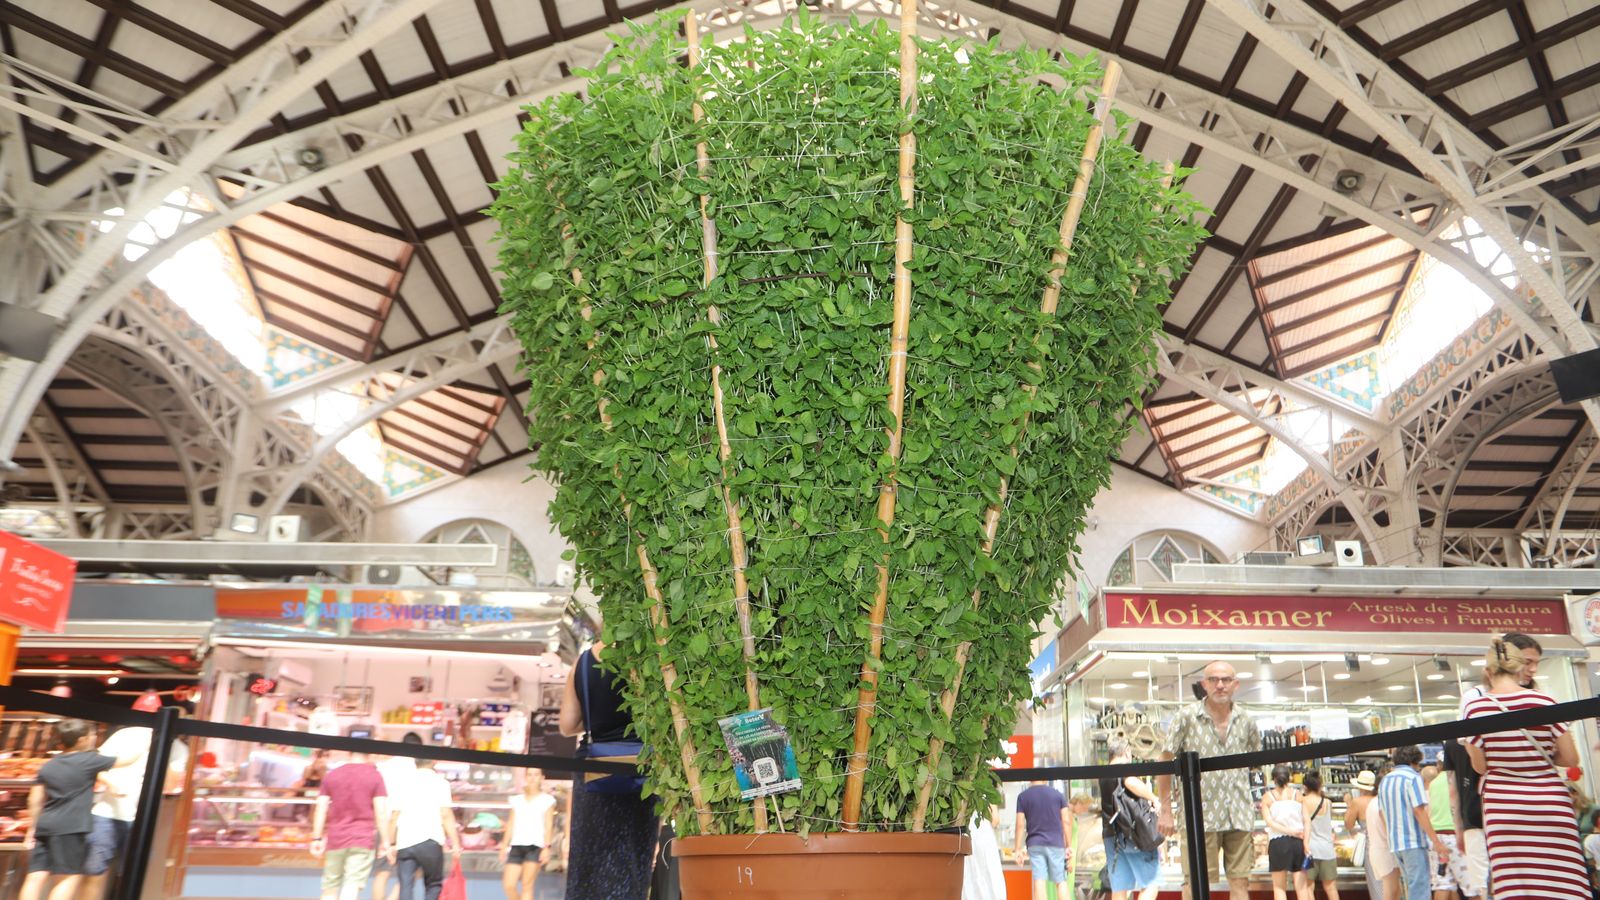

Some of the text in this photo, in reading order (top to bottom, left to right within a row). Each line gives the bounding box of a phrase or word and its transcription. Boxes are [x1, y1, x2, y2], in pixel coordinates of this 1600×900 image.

[1121, 598, 1333, 628] Moixamer
[1347, 601, 1552, 615] Artesà de Saladura
[1369, 614, 1534, 626] Olives i Fumats
[737, 865, 754, 886] 19
